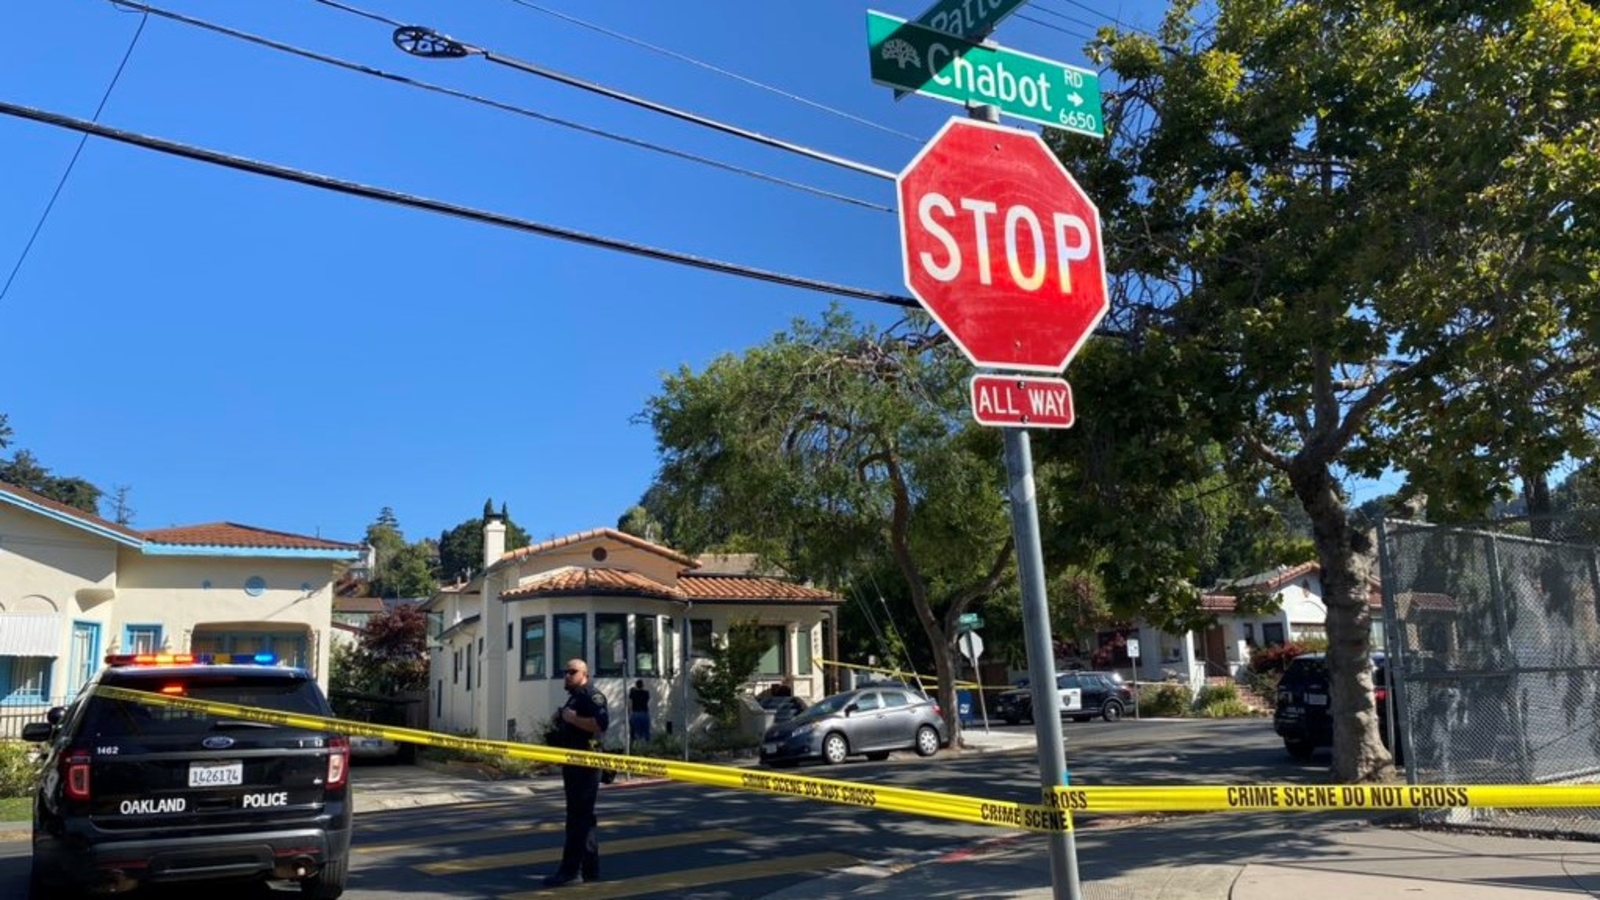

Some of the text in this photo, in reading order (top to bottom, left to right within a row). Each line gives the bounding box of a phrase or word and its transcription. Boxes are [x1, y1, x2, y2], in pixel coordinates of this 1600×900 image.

[927, 43, 1083, 111] Chabot RD
[1059, 107, 1096, 131] 6650
[918, 192, 1091, 294] STOP
[978, 385, 1067, 417] ALL WAY
[192, 768, 239, 784] 1426174
[120, 792, 288, 815] OAKLAND POLICE
[803, 781, 817, 796] DO
[840, 785, 876, 805] CROSS
[1227, 787, 1469, 807] CRIME SCENE DO NOT CROSS
[981, 803, 1068, 830] CRIME SCENE
